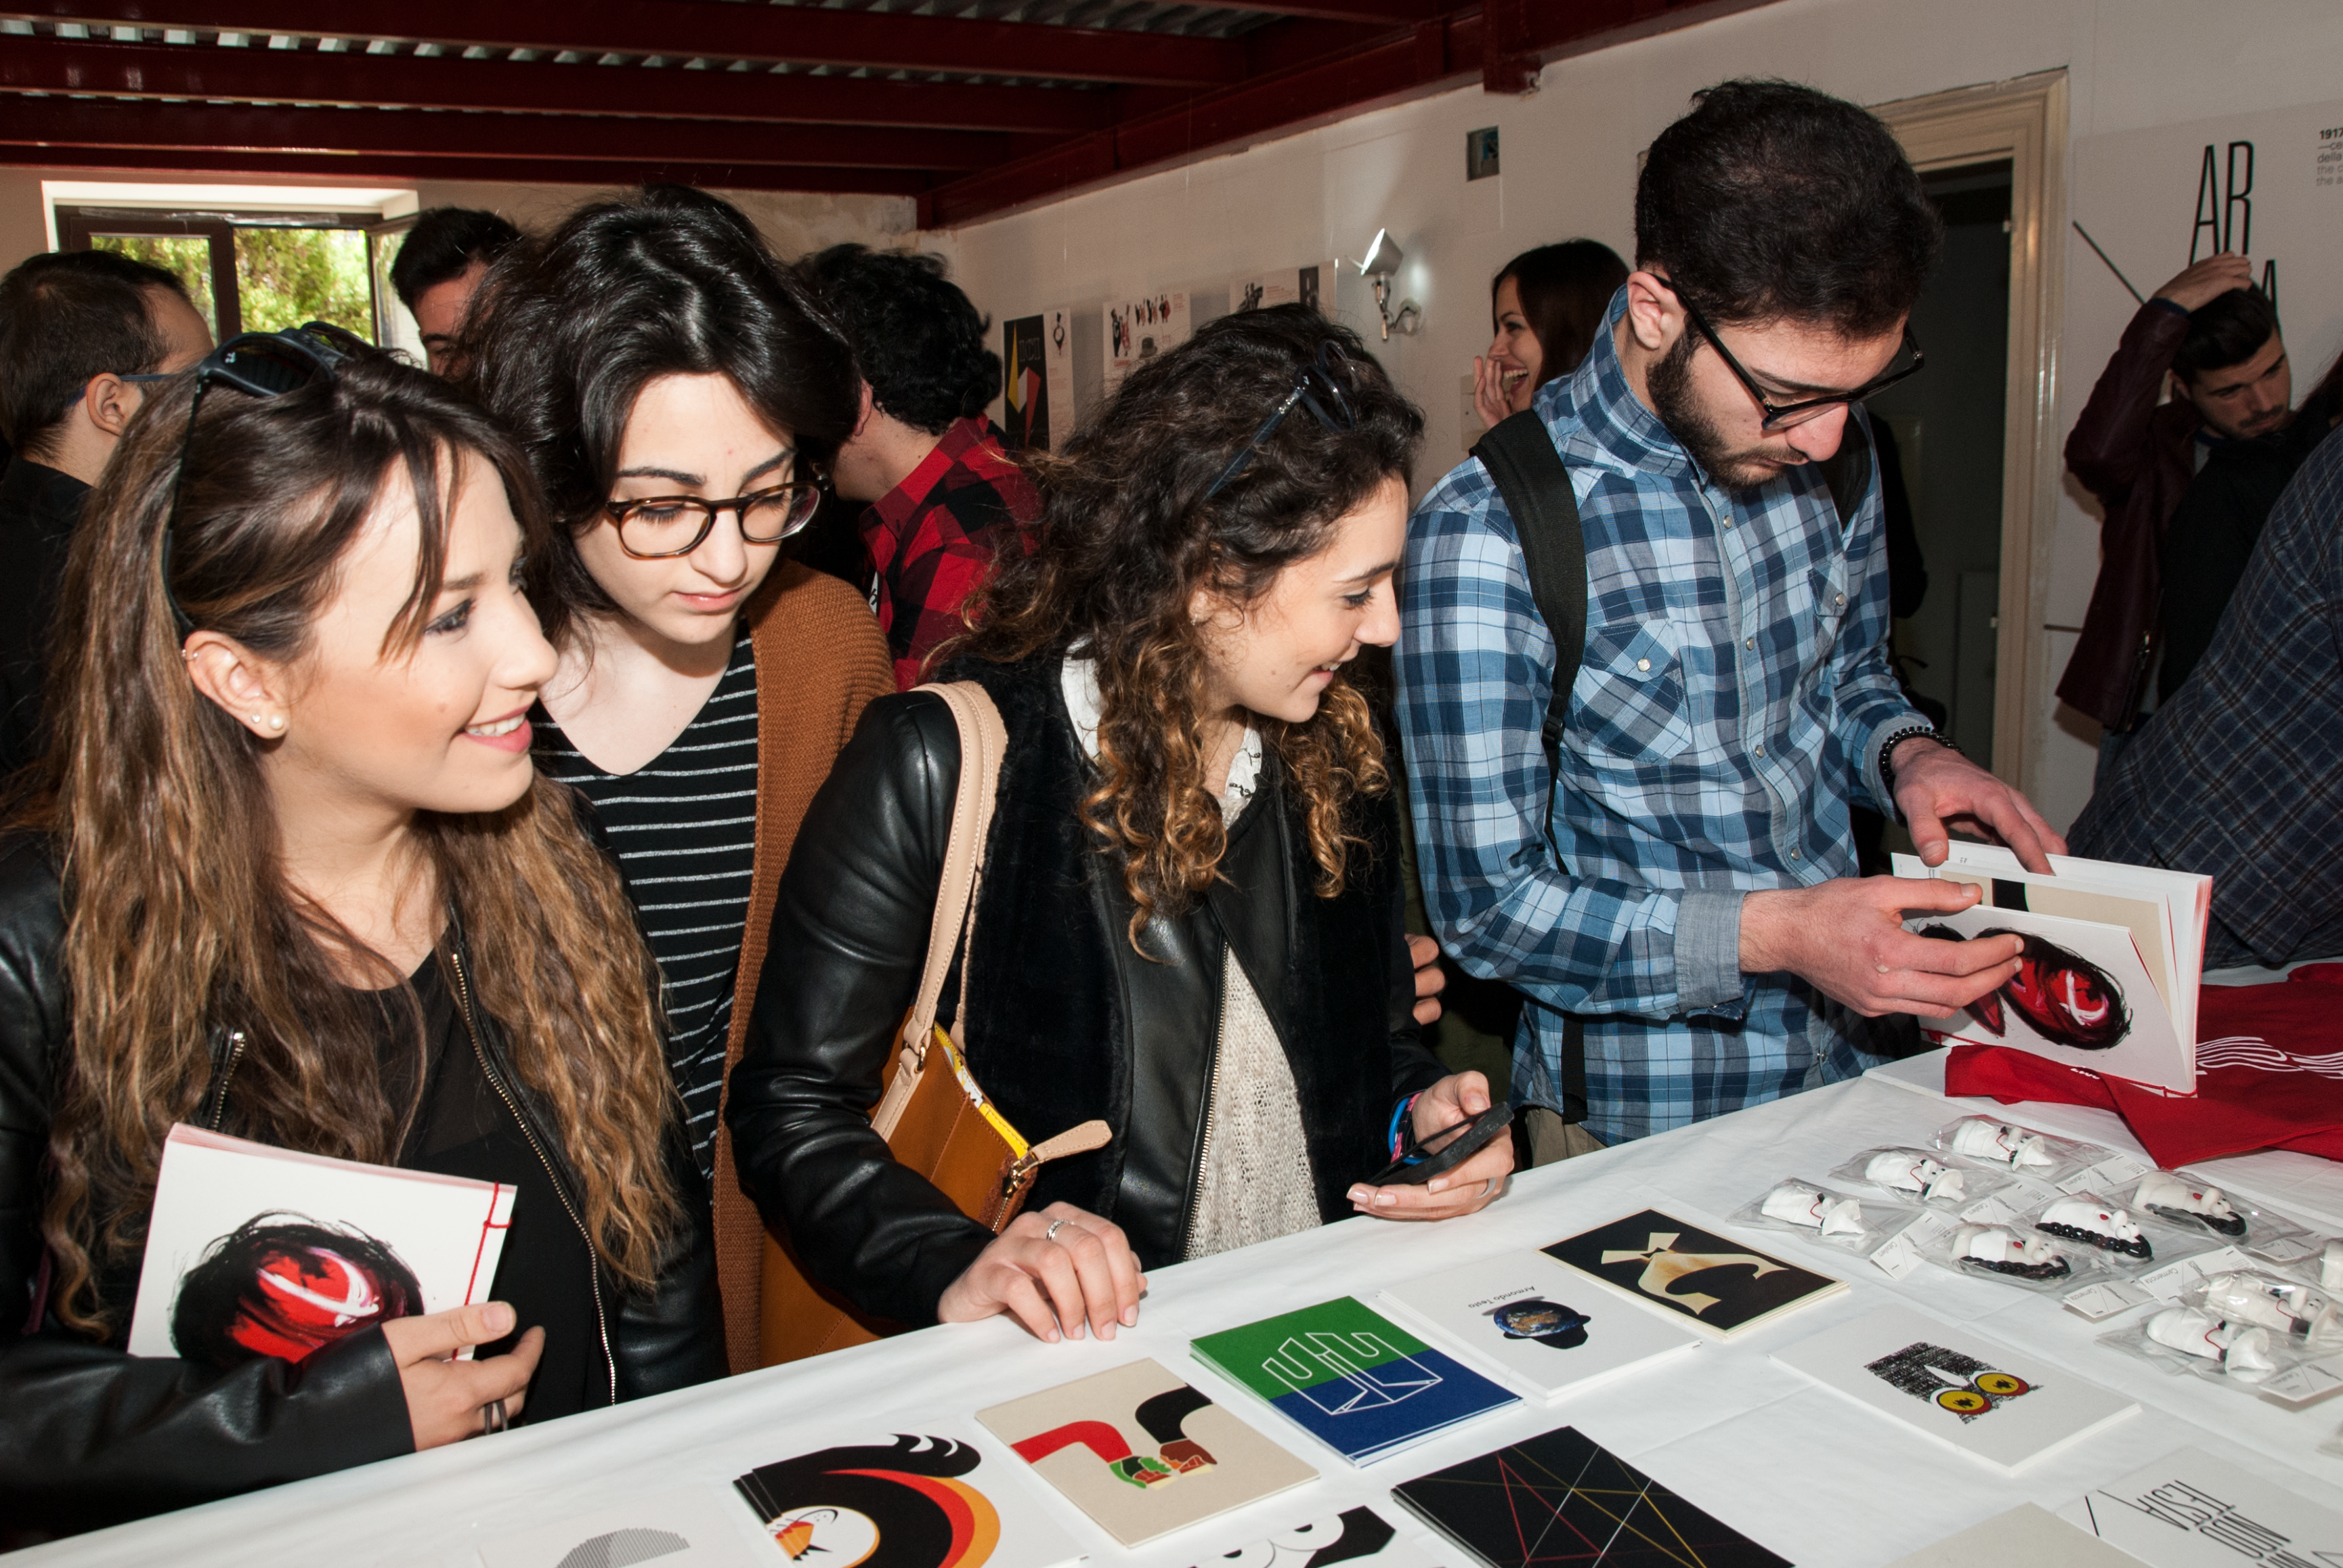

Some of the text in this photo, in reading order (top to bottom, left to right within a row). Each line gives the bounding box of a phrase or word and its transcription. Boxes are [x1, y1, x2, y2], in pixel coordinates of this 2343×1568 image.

[2189, 140, 2254, 267] AR
[2144, 1267, 2178, 1284] Carmencita
[1467, 1299, 1495, 1308] Testa
